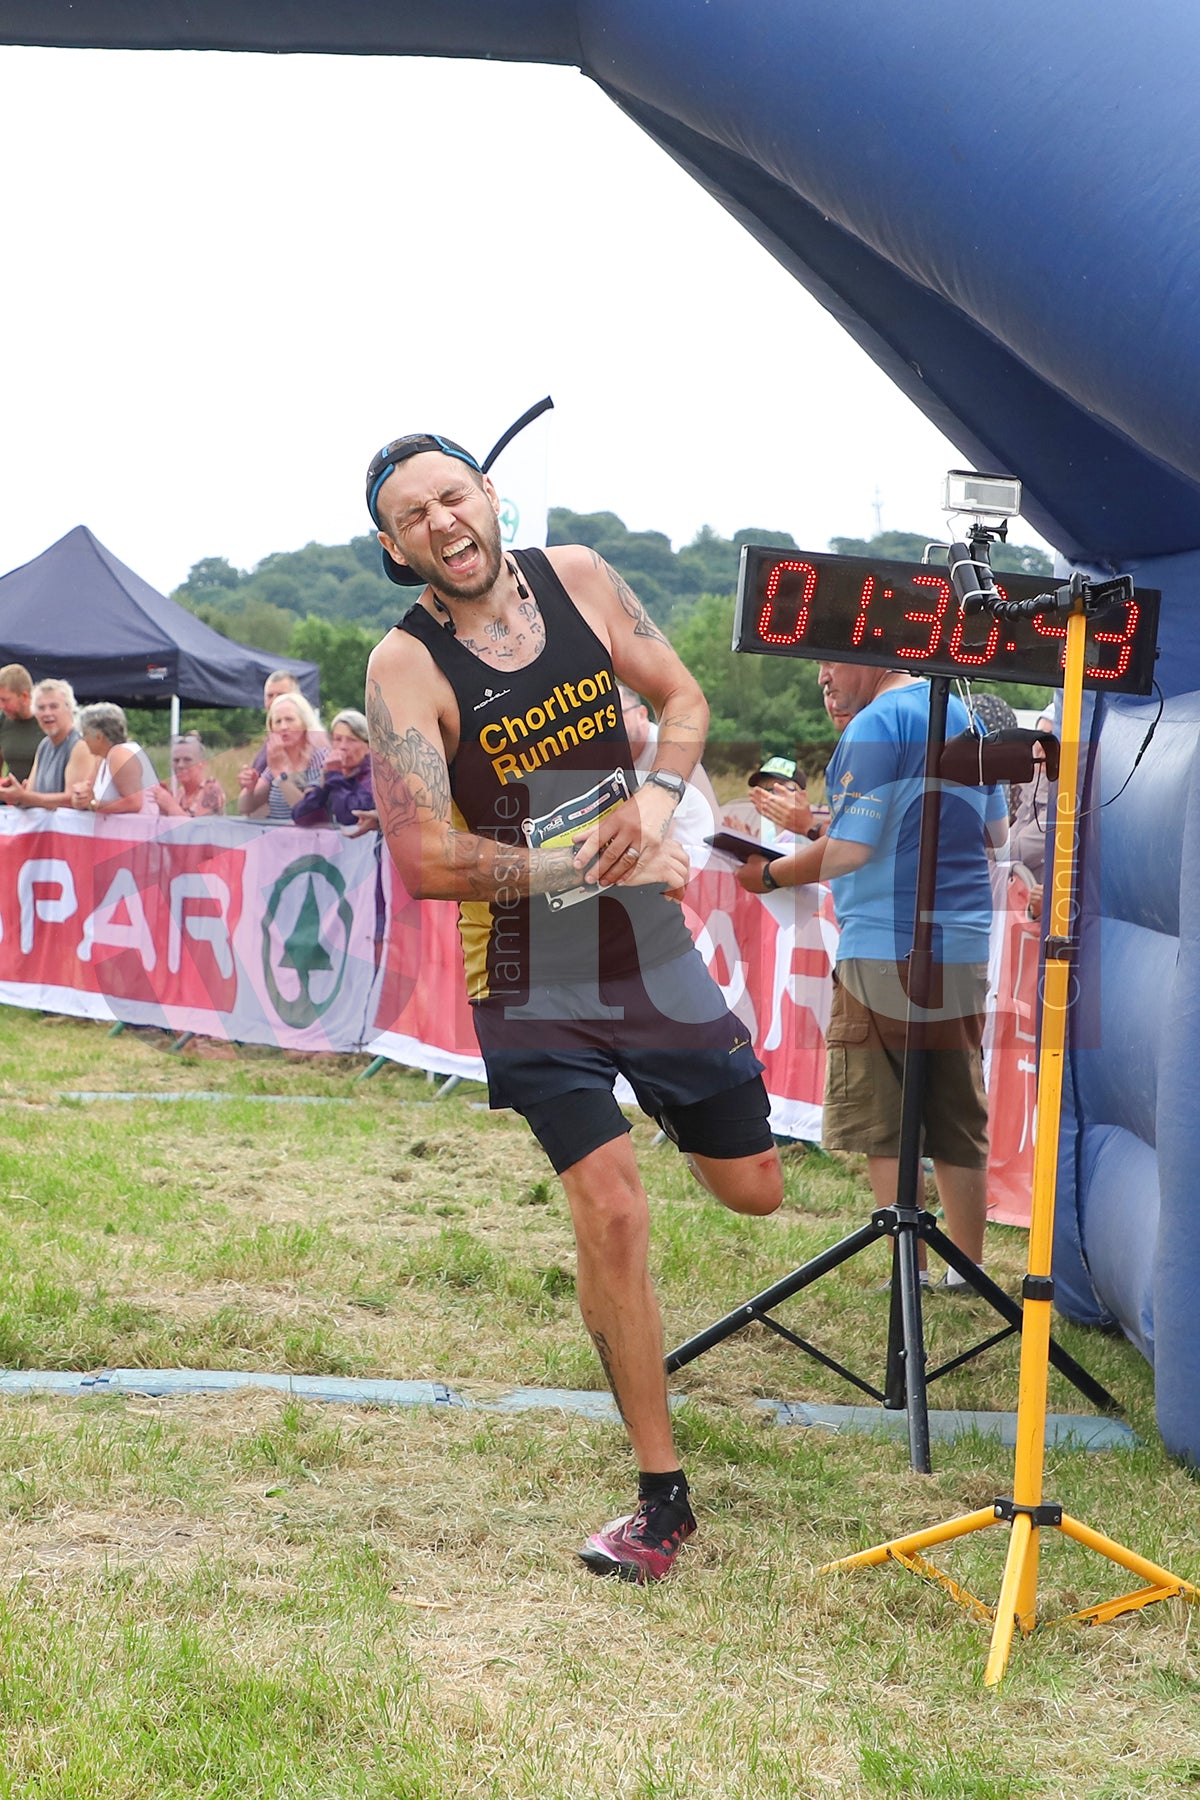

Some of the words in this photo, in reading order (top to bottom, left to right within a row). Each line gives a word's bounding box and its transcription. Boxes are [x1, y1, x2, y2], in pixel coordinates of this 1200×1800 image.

[479, 669, 613, 754] Chorlton
[491, 703, 618, 787] Runners
[0, 858, 235, 980] PAR
